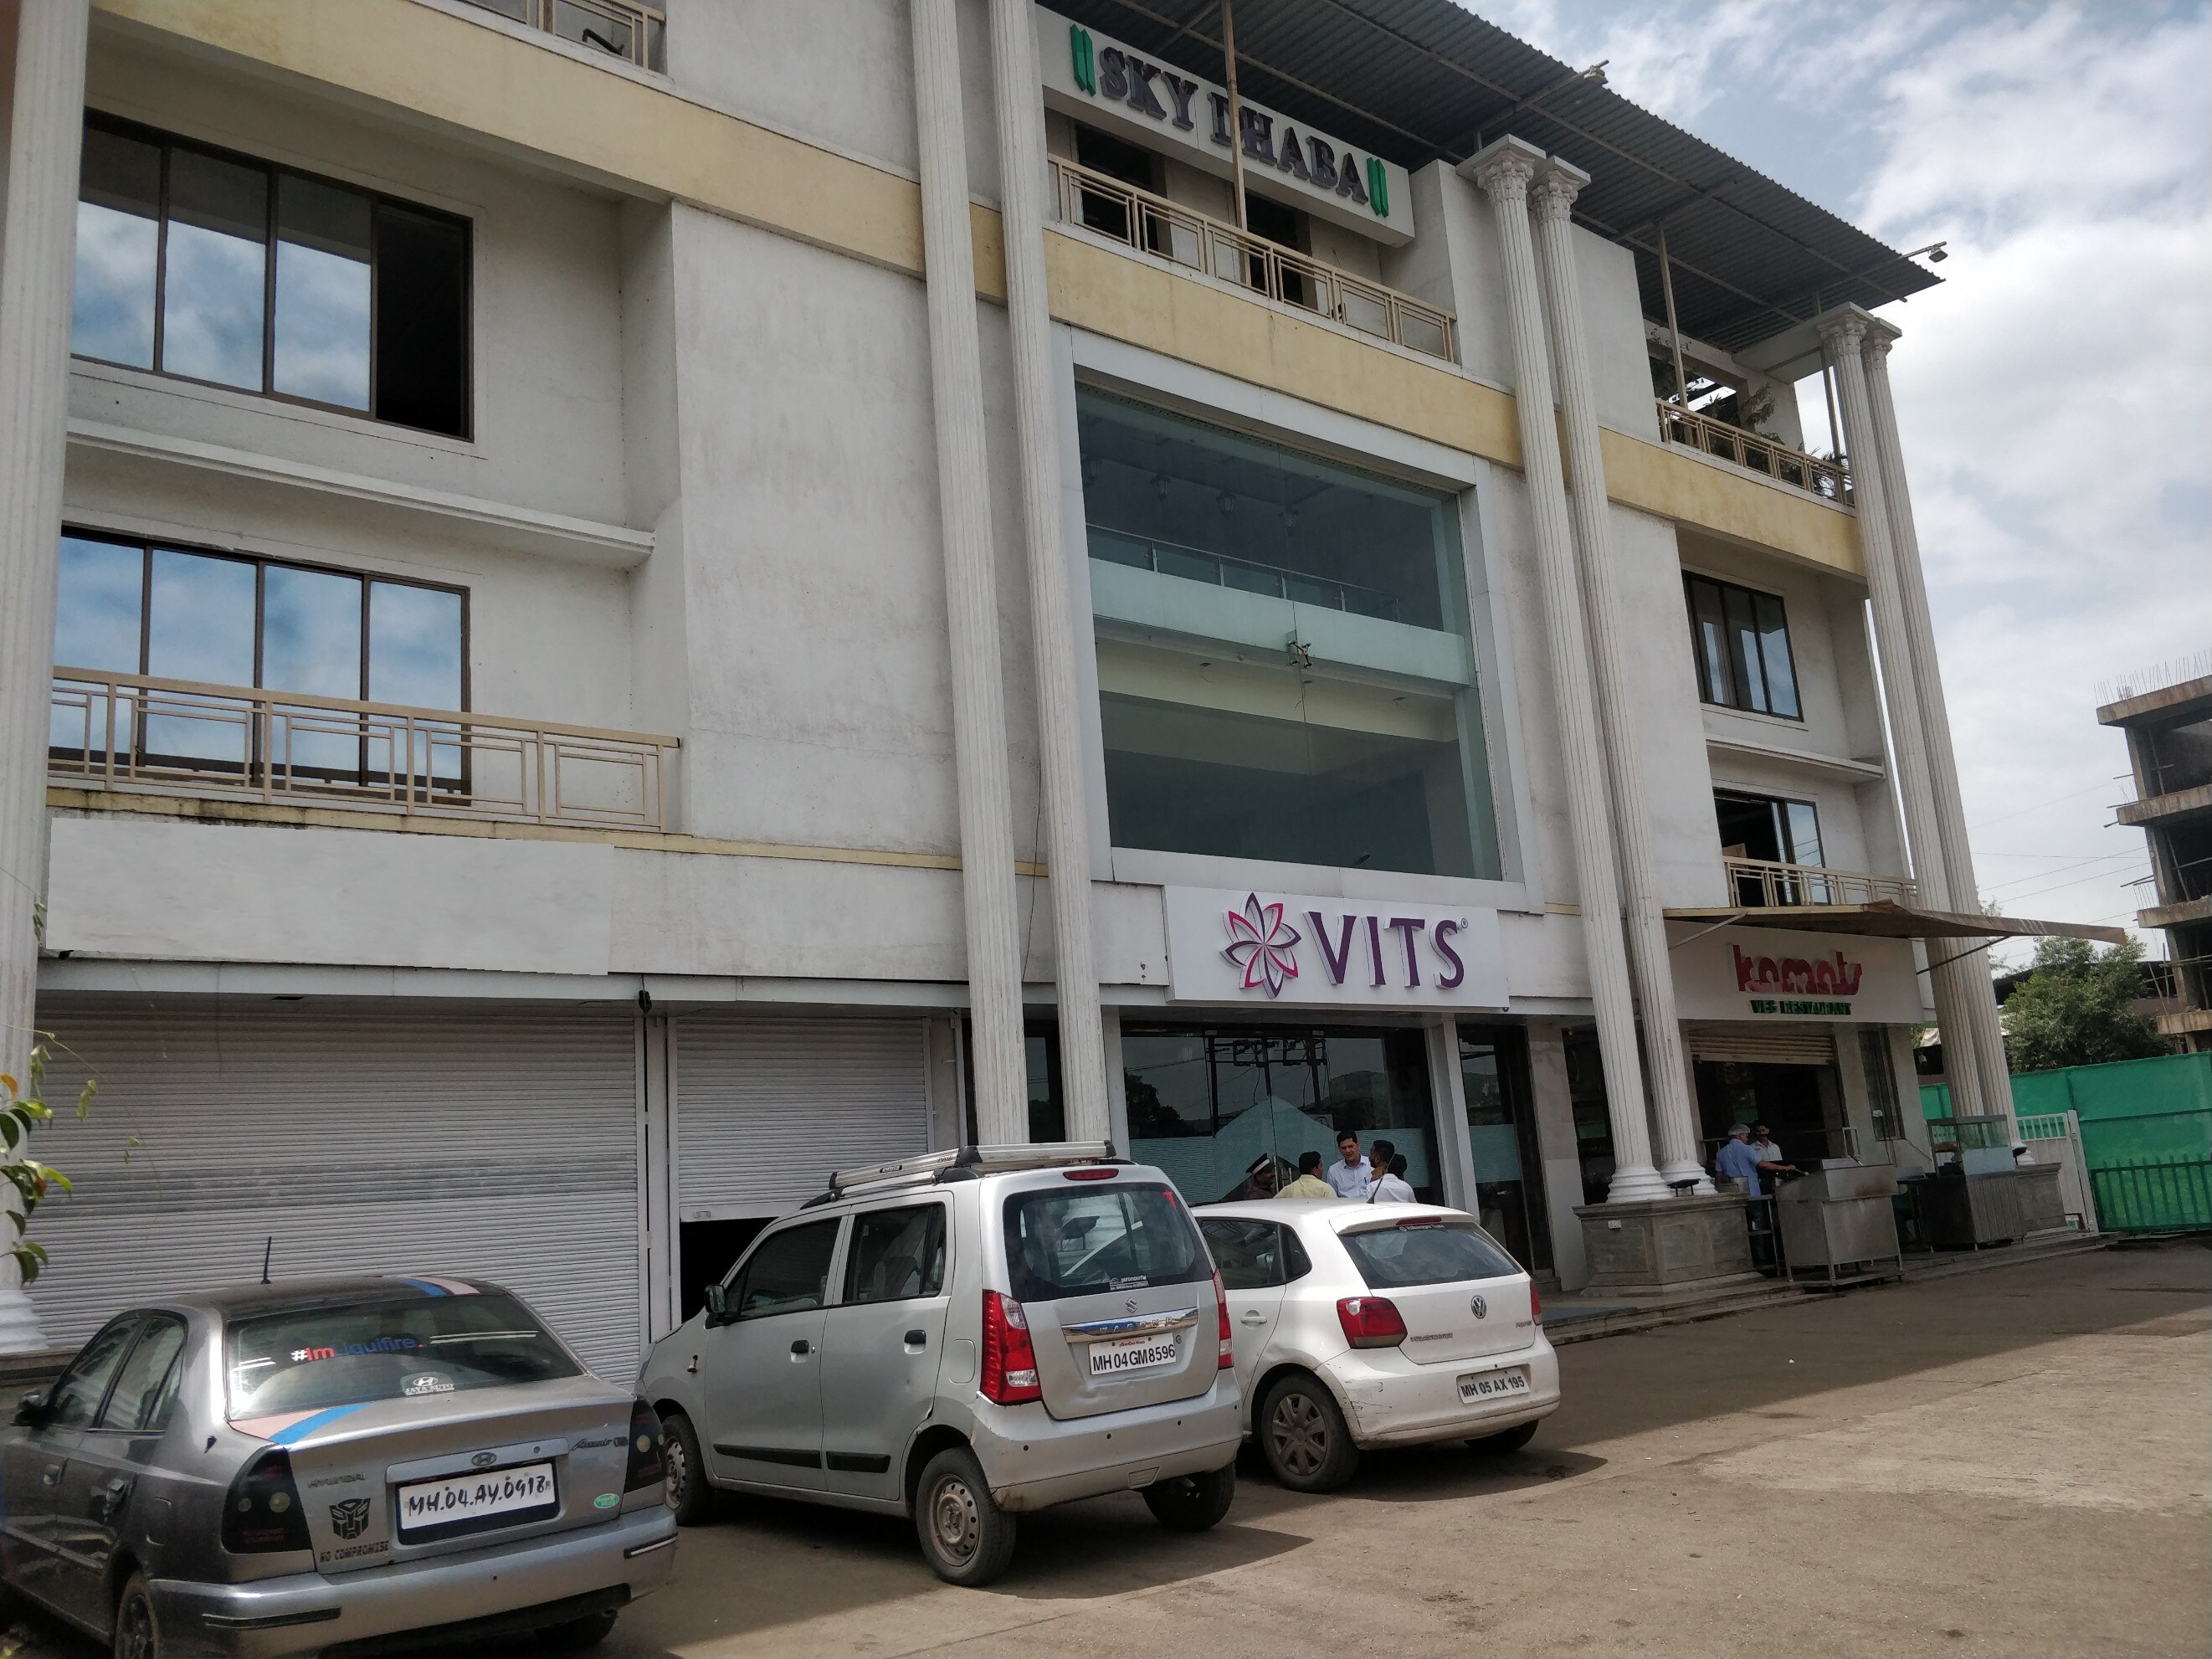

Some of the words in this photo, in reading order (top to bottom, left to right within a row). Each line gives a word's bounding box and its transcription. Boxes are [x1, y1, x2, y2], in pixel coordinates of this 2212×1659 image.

[1099, 46, 1198, 131] SKY
[1304, 911, 1465, 989] VITS
[1750, 1000, 1778, 1014] VEG
[1779, 1001, 1852, 1015] RESTAURANT
[1460, 1384, 1479, 1397] MH
[1479, 1382, 1492, 1394] 05
[1494, 1379, 1508, 1391] AX
[1507, 1375, 1525, 1389] 195
[335, 1540, 389, 1560] COMPROMISE
